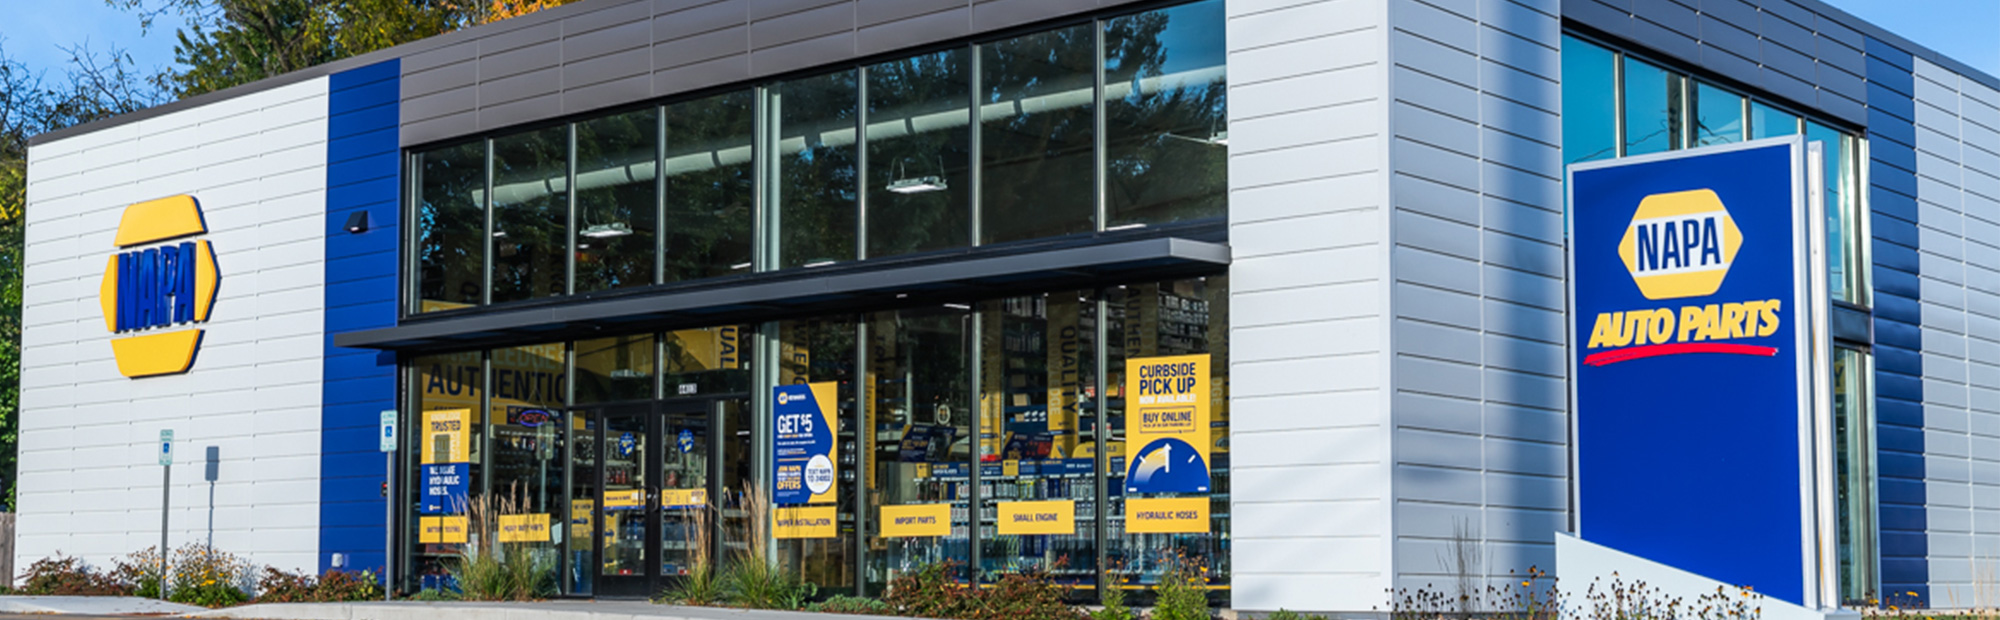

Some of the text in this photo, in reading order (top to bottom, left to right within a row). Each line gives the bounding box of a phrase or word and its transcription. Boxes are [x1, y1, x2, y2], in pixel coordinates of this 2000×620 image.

[1637, 217, 1721, 272] NAPA
[115, 242, 196, 333] NAPA
[1586, 299, 1782, 349] AUTO PARTS
[1060, 325, 1077, 414] QUALITY
[1138, 362, 1197, 379] CURBSIDE
[1139, 377, 1197, 396] PICK UP
[1138, 395, 1156, 405] NOW
[518, 412, 549, 424] OPEN
[777, 413, 813, 434] GET $5
[1142, 410, 1192, 424] BUY ONLINE
[430, 420, 462, 433] TRUSTED
[776, 481, 802, 490] OFFERS
[894, 515, 936, 525] IMPORT PARTS
[1013, 512, 1058, 523] SMALL ENGINE
[1136, 510, 1199, 521] HYDRAULIC HOSES
[794, 518, 832, 527] INSTALLATION
